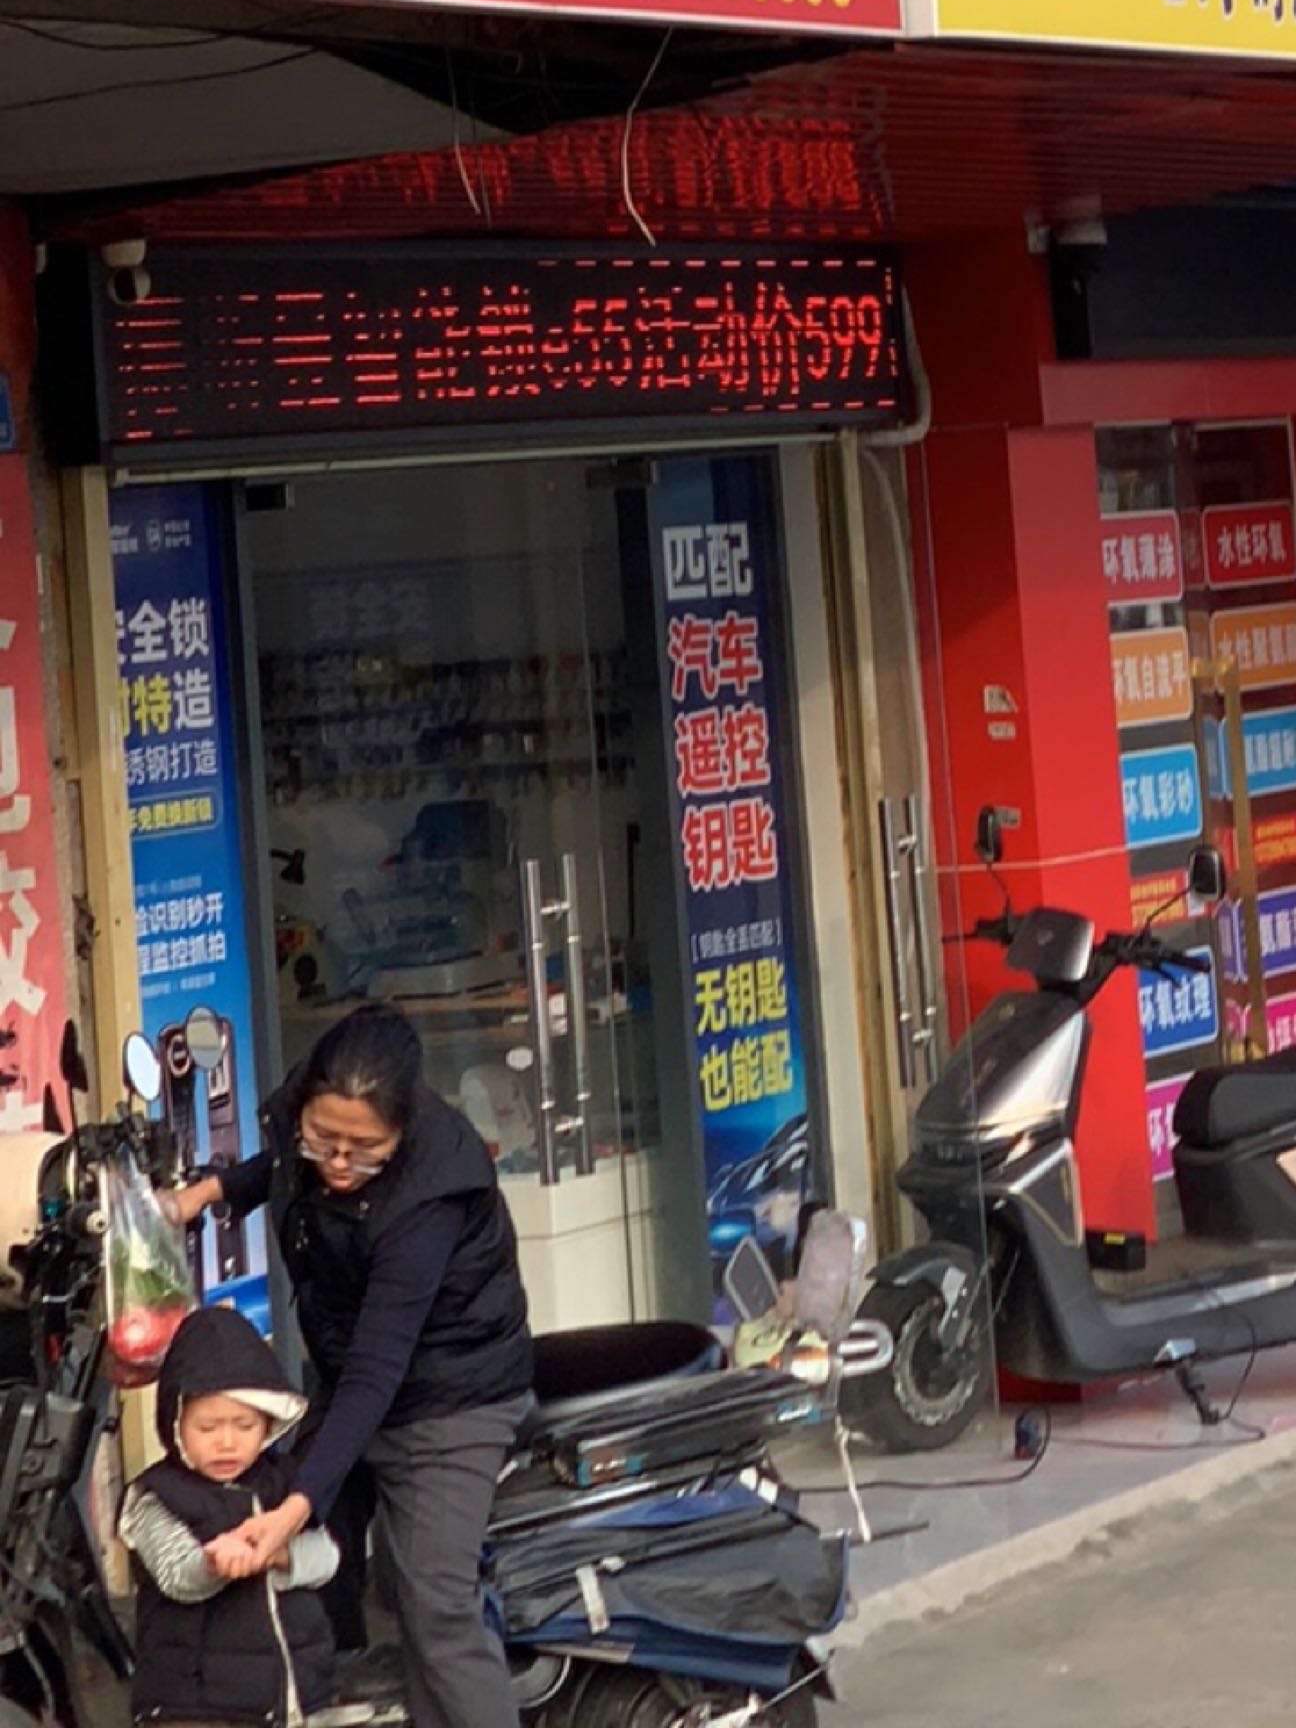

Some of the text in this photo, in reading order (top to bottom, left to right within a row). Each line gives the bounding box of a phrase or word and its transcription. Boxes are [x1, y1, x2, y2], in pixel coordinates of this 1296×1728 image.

[663, 520, 752, 600] 匹配
[668, 610, 762, 702] 汽车
[674, 702, 770, 797] 遥控
[681, 797, 777, 891] 钥匙
[695, 957, 787, 1036] 无钥匙
[700, 1029, 793, 1111] 也能配
